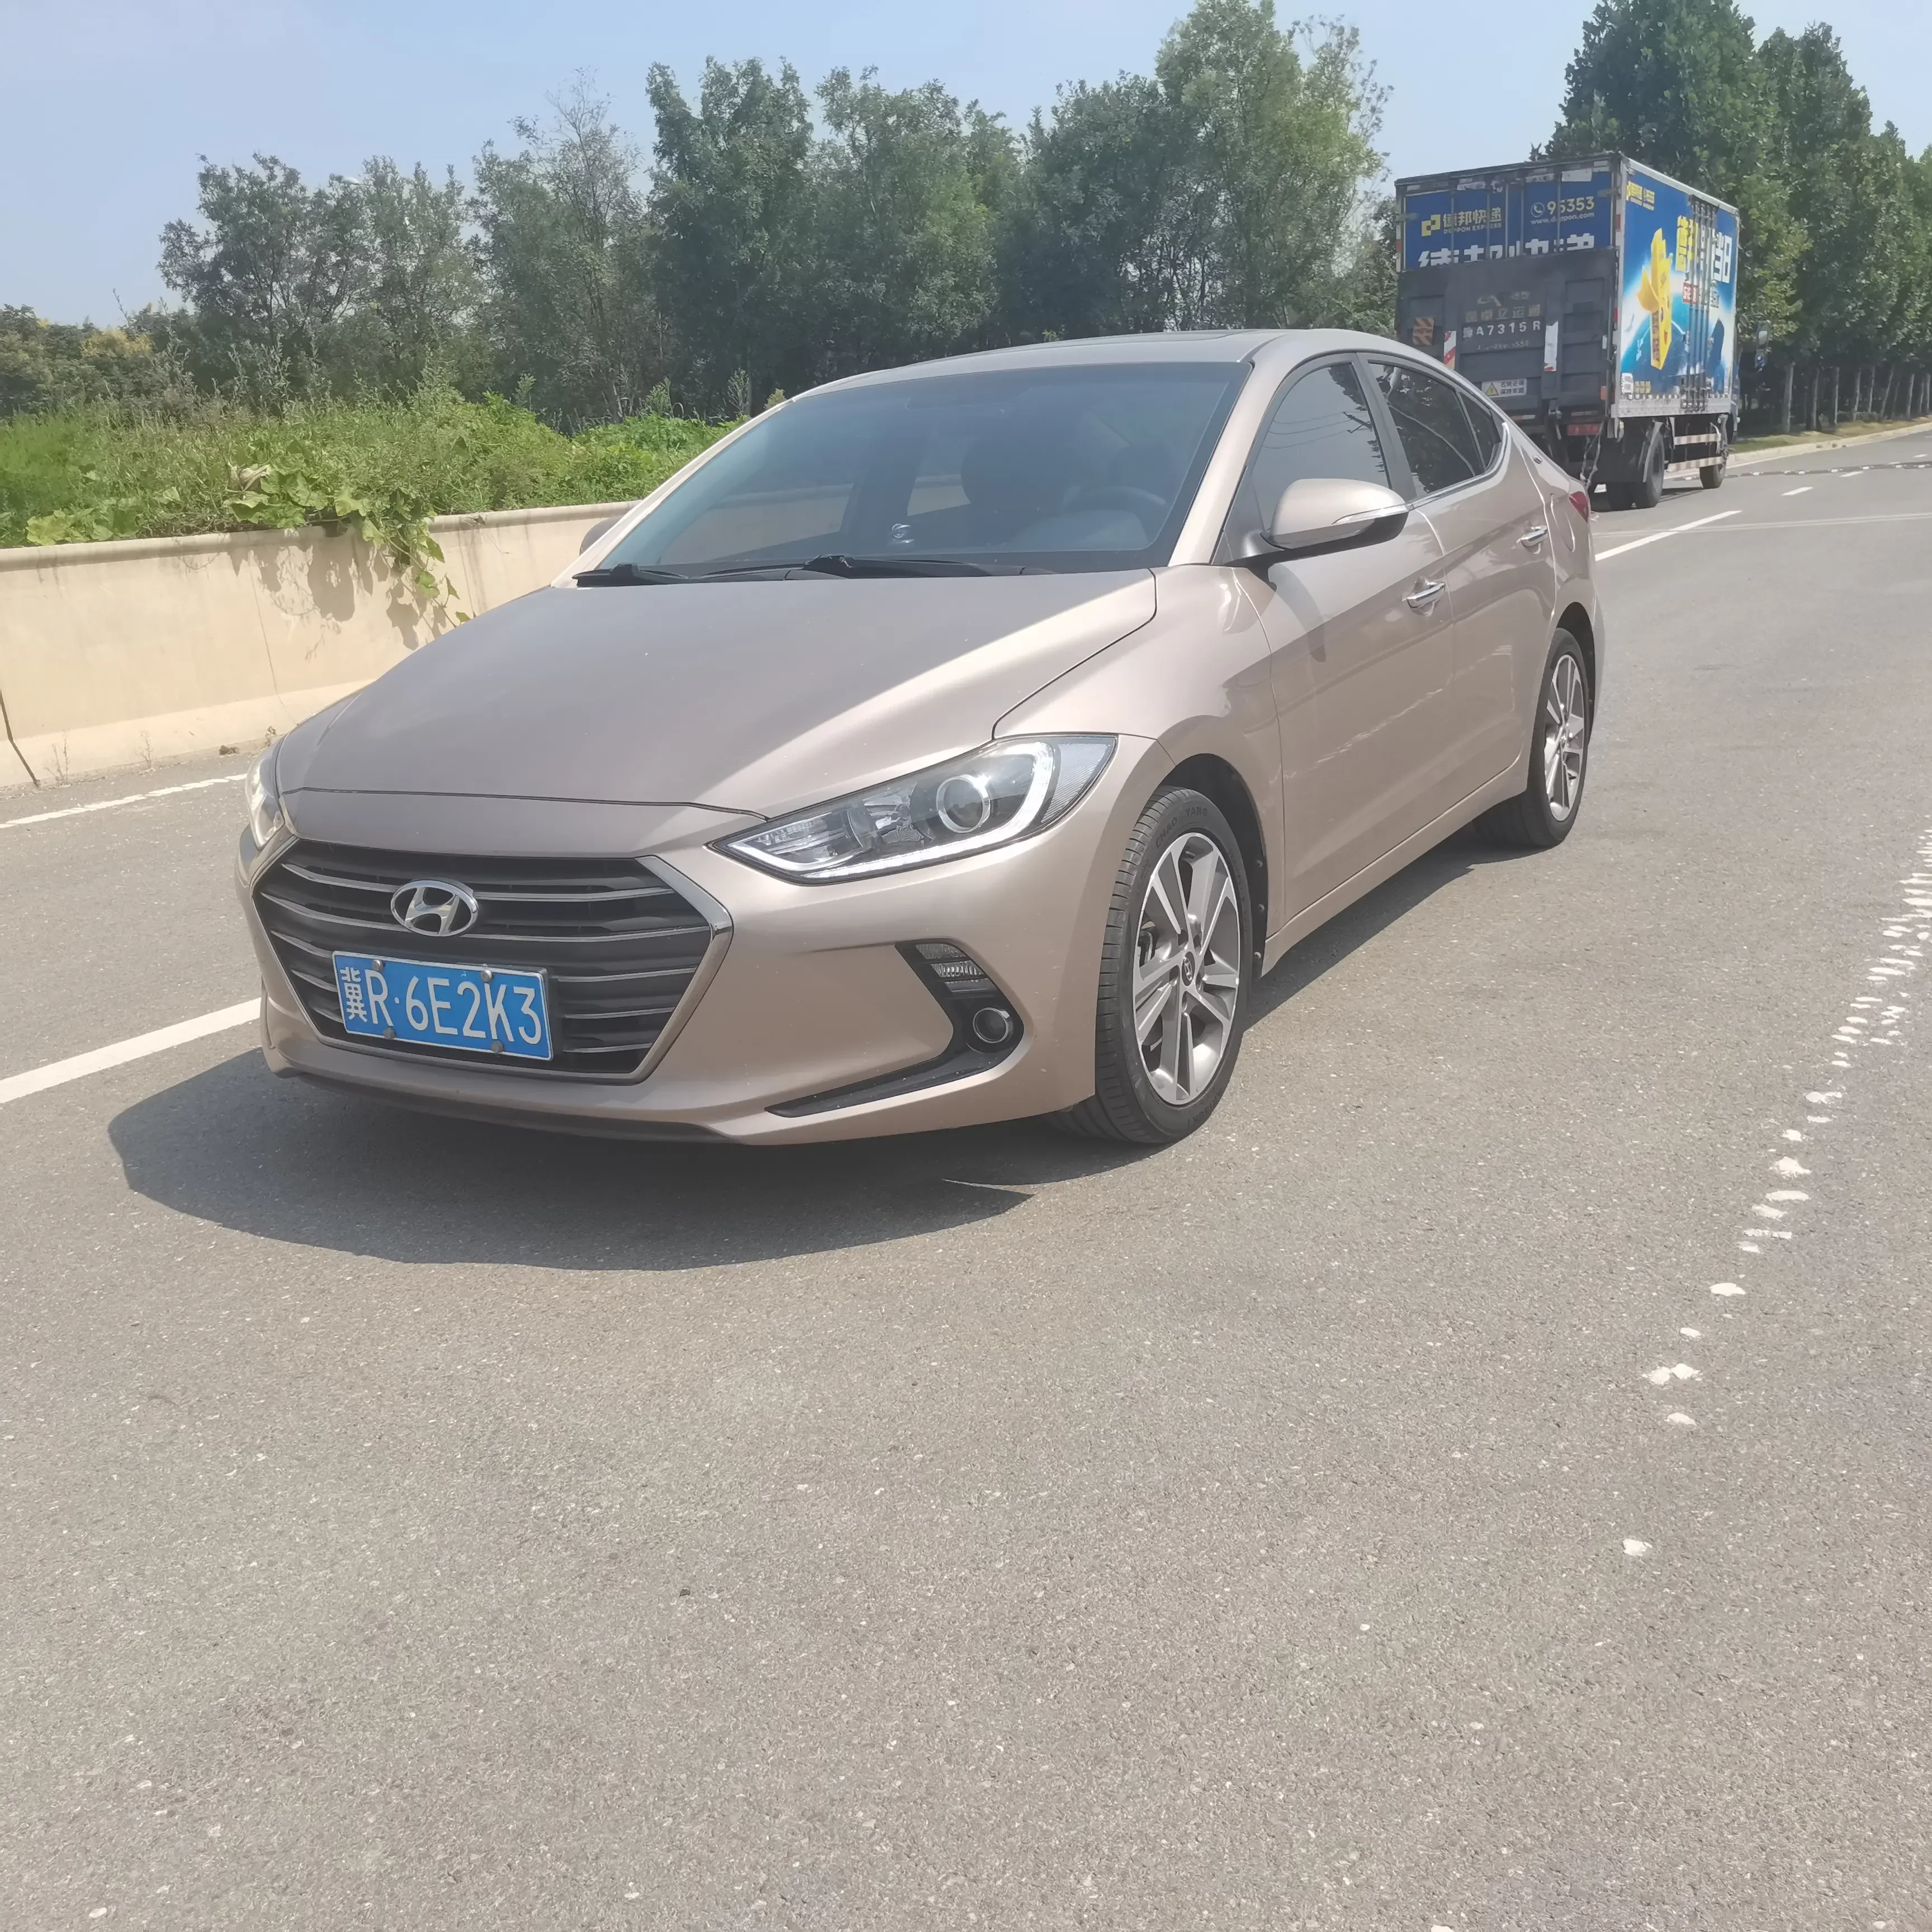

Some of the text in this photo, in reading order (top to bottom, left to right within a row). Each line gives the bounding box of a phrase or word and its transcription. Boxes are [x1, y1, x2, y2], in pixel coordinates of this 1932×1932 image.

[1547, 196, 1594, 215] 95353
[1472, 222, 1502, 231] EXPESS
[1156, 806, 1208, 849] CHAO YANG
[340, 966, 542, 1044] 冀R·6E2K3
